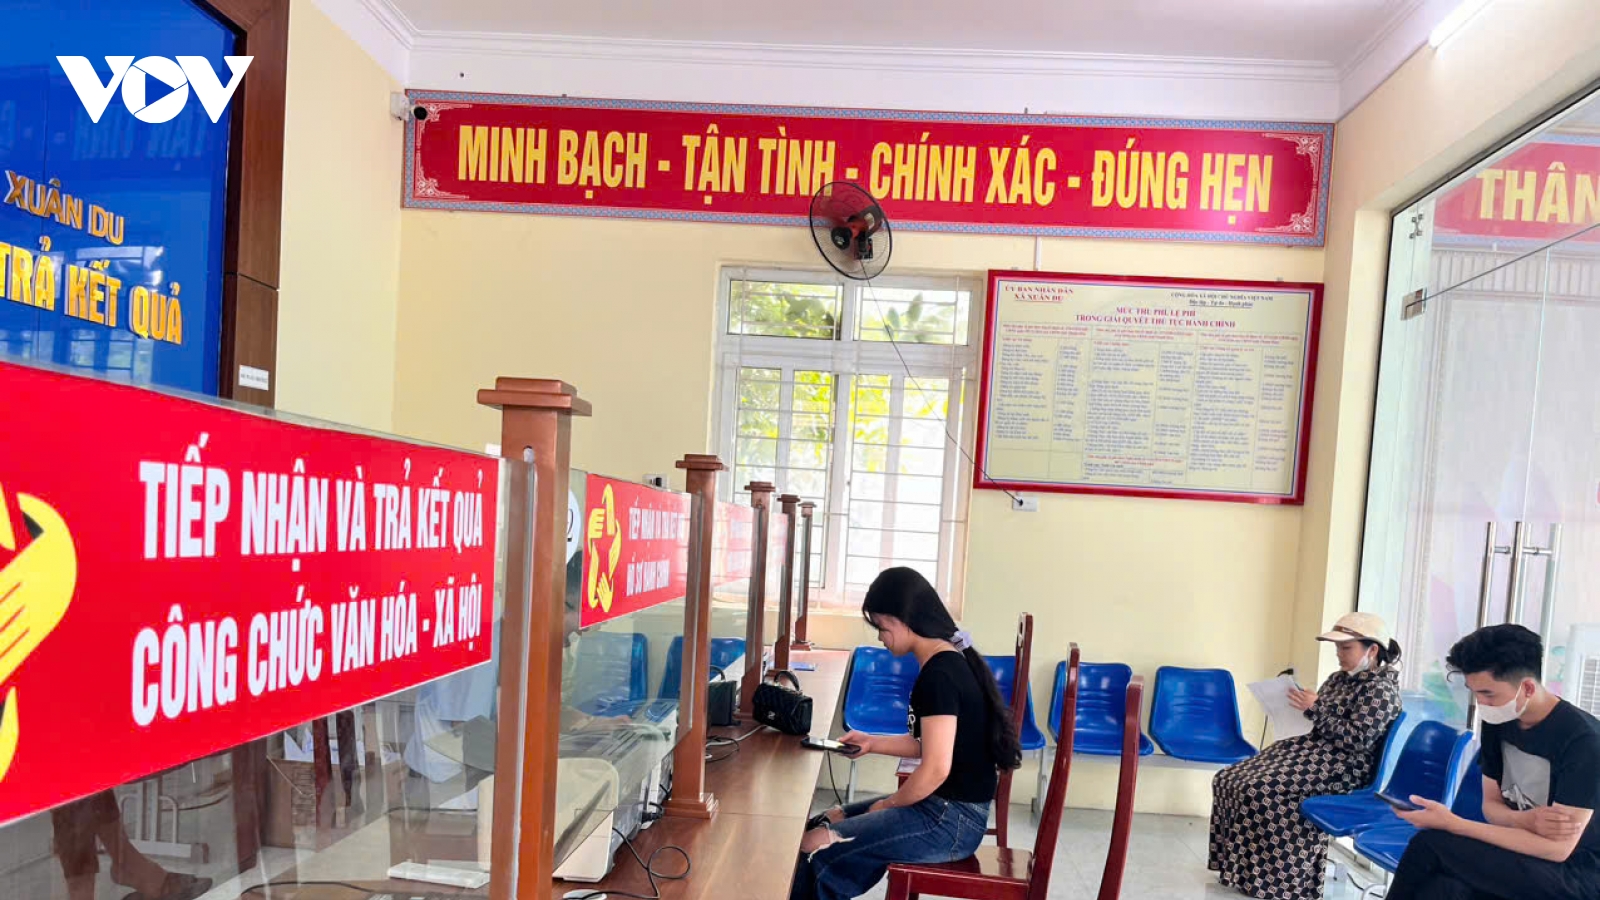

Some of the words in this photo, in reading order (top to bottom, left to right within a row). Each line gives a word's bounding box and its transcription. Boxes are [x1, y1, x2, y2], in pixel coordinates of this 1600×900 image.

[4, 170, 84, 230] XUÂN
[88, 204, 125, 246] DU
[458, 125, 546, 184] MINH
[557, 128, 648, 198] BẠCH
[659, 160, 671, 171] -
[683, 125, 748, 204] TẬN
[758, 127, 836, 196] TÌNH
[869, 132, 976, 203] CHÍNH
[986, 135, 1056, 205] XÁC
[1068, 174, 1080, 188] -
[1091, 138, 1191, 210] ĐÚNG
[1201, 152, 1273, 225] HẸN
[1475, 161, 1600, 224] THÂN
[0, 236, 56, 311] TRẢ
[64, 260, 122, 327] KẾT
[129, 282, 183, 344] QUẢ
[1076, 314, 1102, 322] TRONG
[139, 432, 230, 559] TIẾP
[241, 458, 329, 572] NHẬN
[336, 465, 366, 552] VÀ
[373, 458, 412, 550] TRẢ
[416, 467, 450, 549] KẾT
[453, 469, 483, 554] QUẢ
[132, 604, 238, 727] CÔNG
[247, 586, 324, 697] CHỨC
[331, 586, 376, 674] VĂN
[380, 580, 418, 662] HÓA
[422, 618, 430, 632] -
[432, 576, 454, 648] XÃ
[458, 572, 482, 651] HỘI
